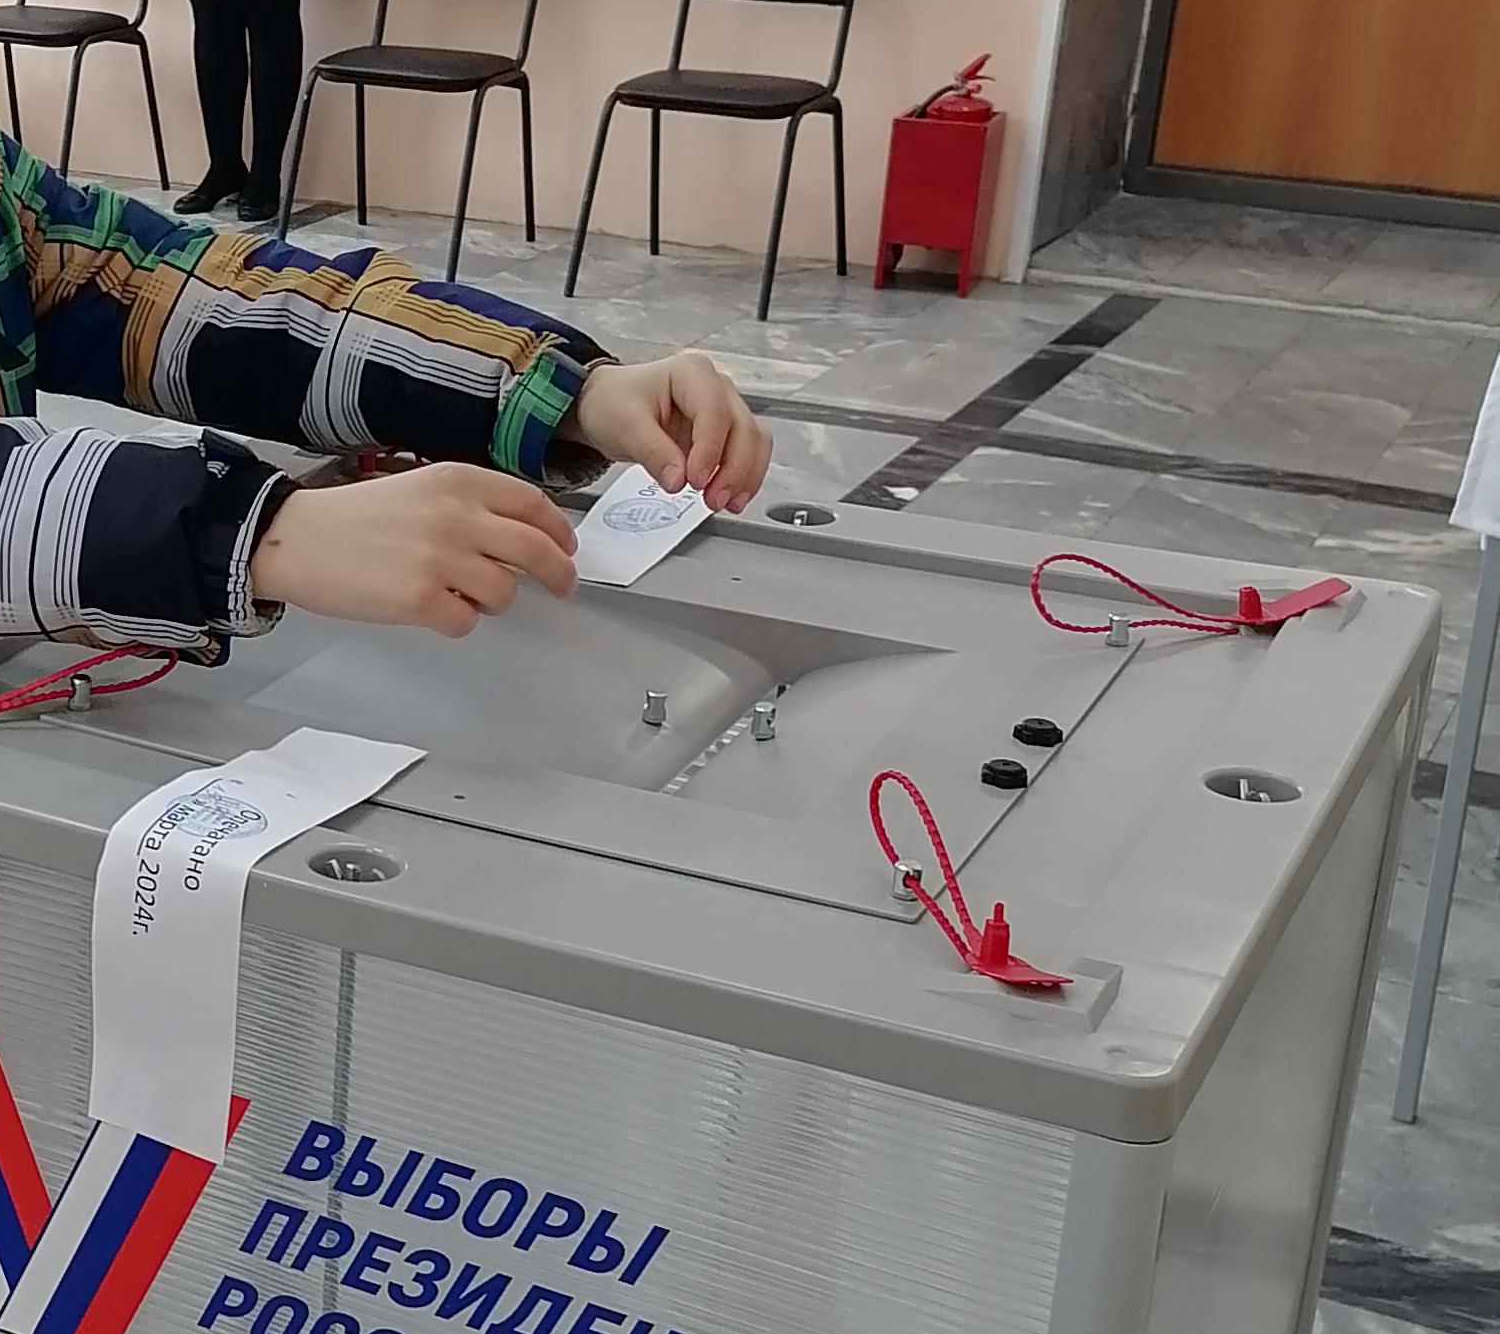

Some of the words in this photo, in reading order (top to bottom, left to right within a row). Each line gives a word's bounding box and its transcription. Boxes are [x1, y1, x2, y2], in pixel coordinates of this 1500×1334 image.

[184, 809, 262, 891] Опечатано
[132, 858, 160, 936] 2024г.
[284, 1120, 670, 1286] ВЫБОРЫ
